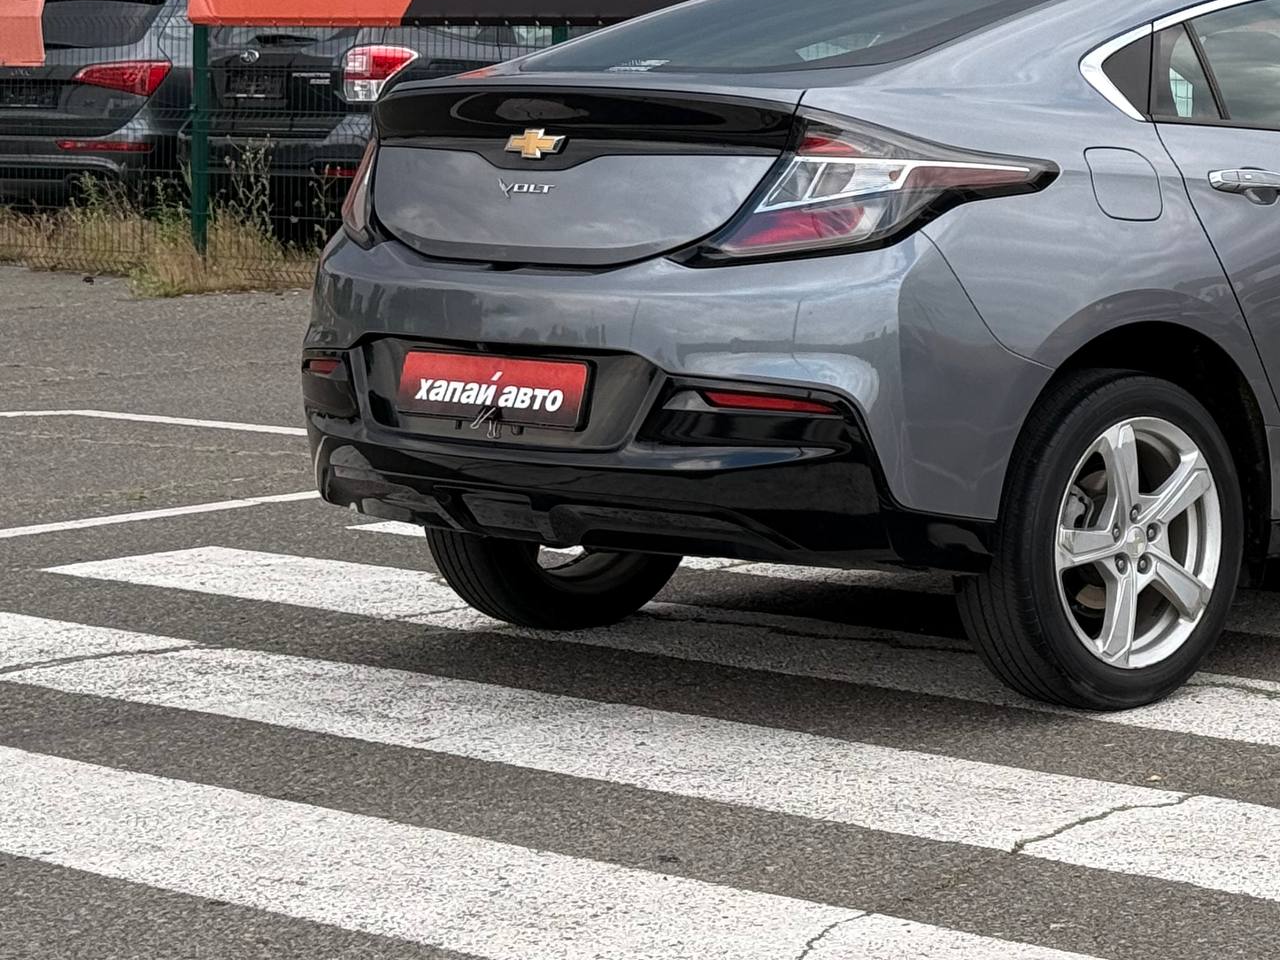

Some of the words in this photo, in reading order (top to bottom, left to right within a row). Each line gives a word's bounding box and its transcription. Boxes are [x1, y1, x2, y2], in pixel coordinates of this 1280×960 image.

[498, 177, 556, 198] VOLT
[414, 371, 503, 406] хапай
[497, 384, 564, 412] авто
